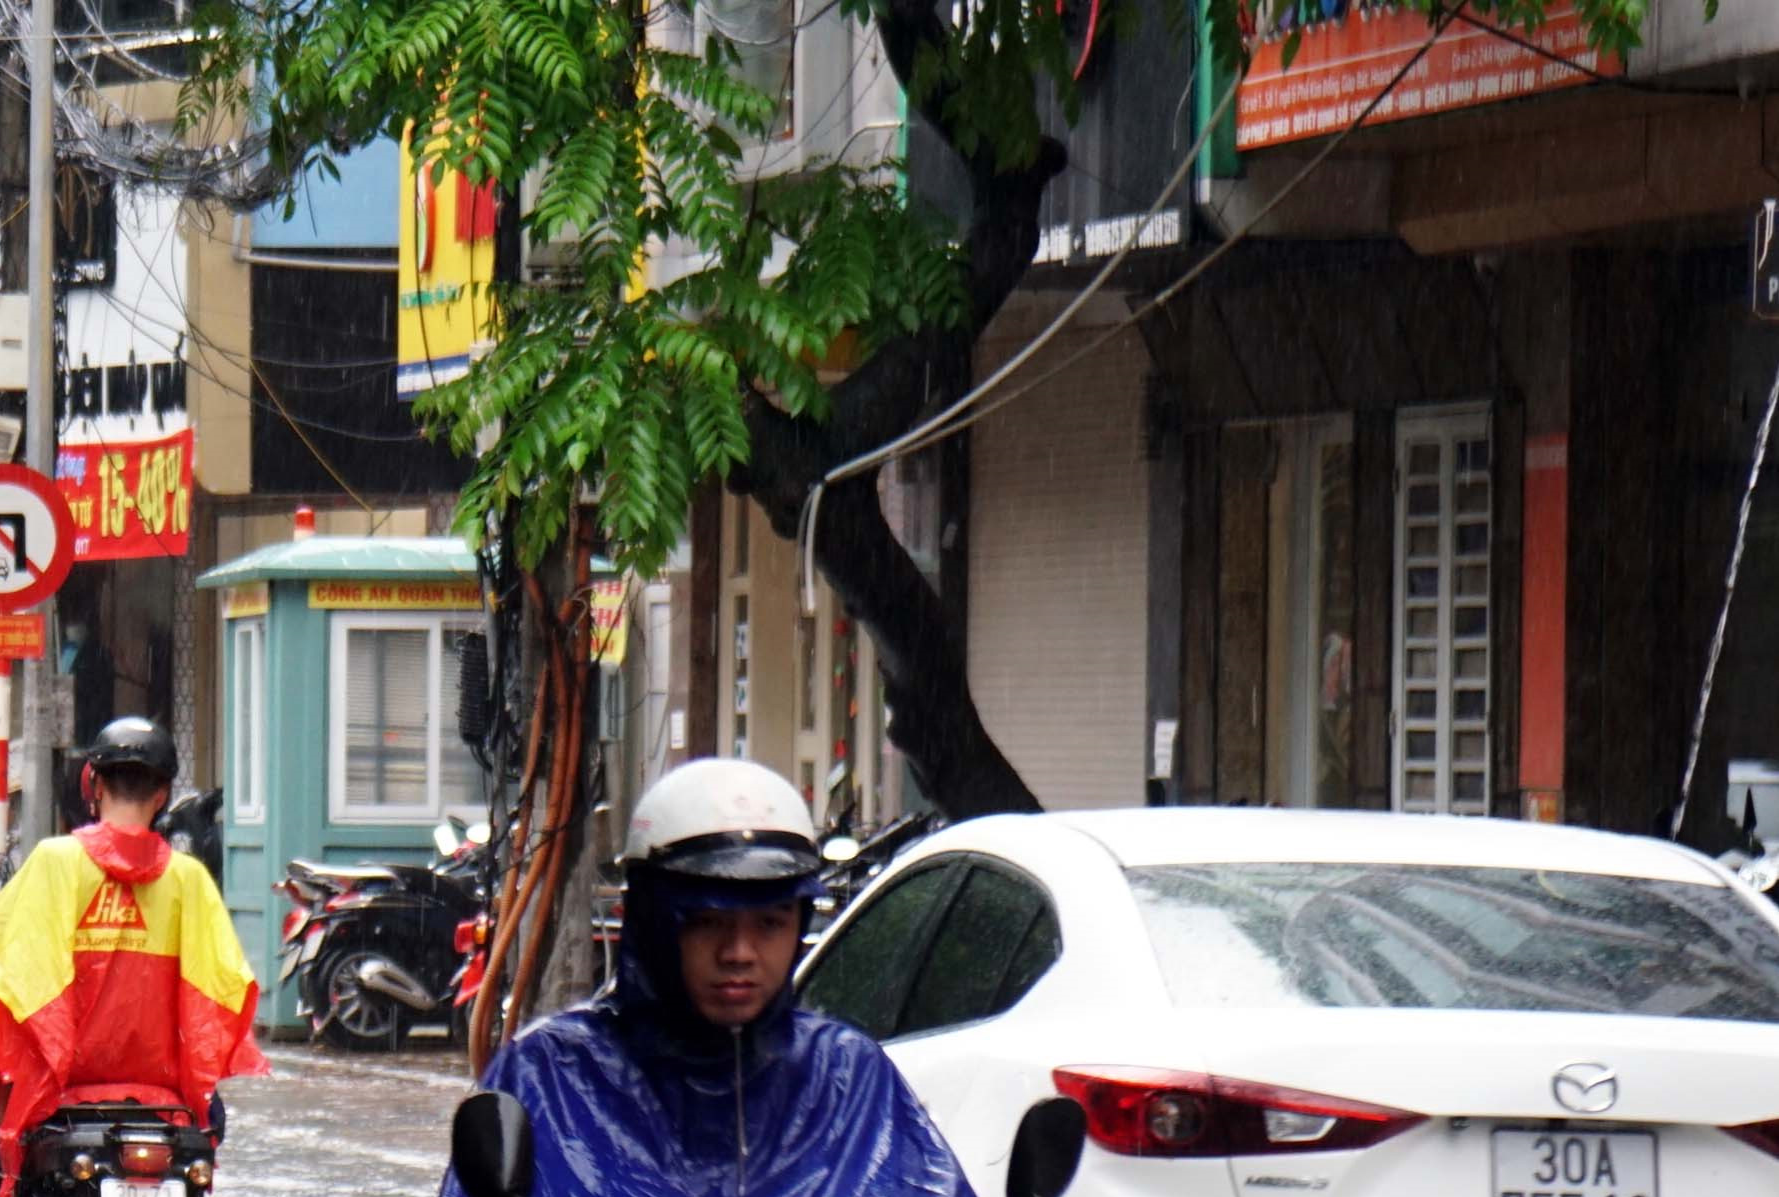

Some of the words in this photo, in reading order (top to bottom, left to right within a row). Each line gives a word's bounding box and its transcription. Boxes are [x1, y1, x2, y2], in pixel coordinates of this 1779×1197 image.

[99, 446, 189, 538] 15-40%
[369, 580, 391, 602] AN
[86, 883, 137, 923] Sika
[1533, 1136, 1616, 1186] 30A
